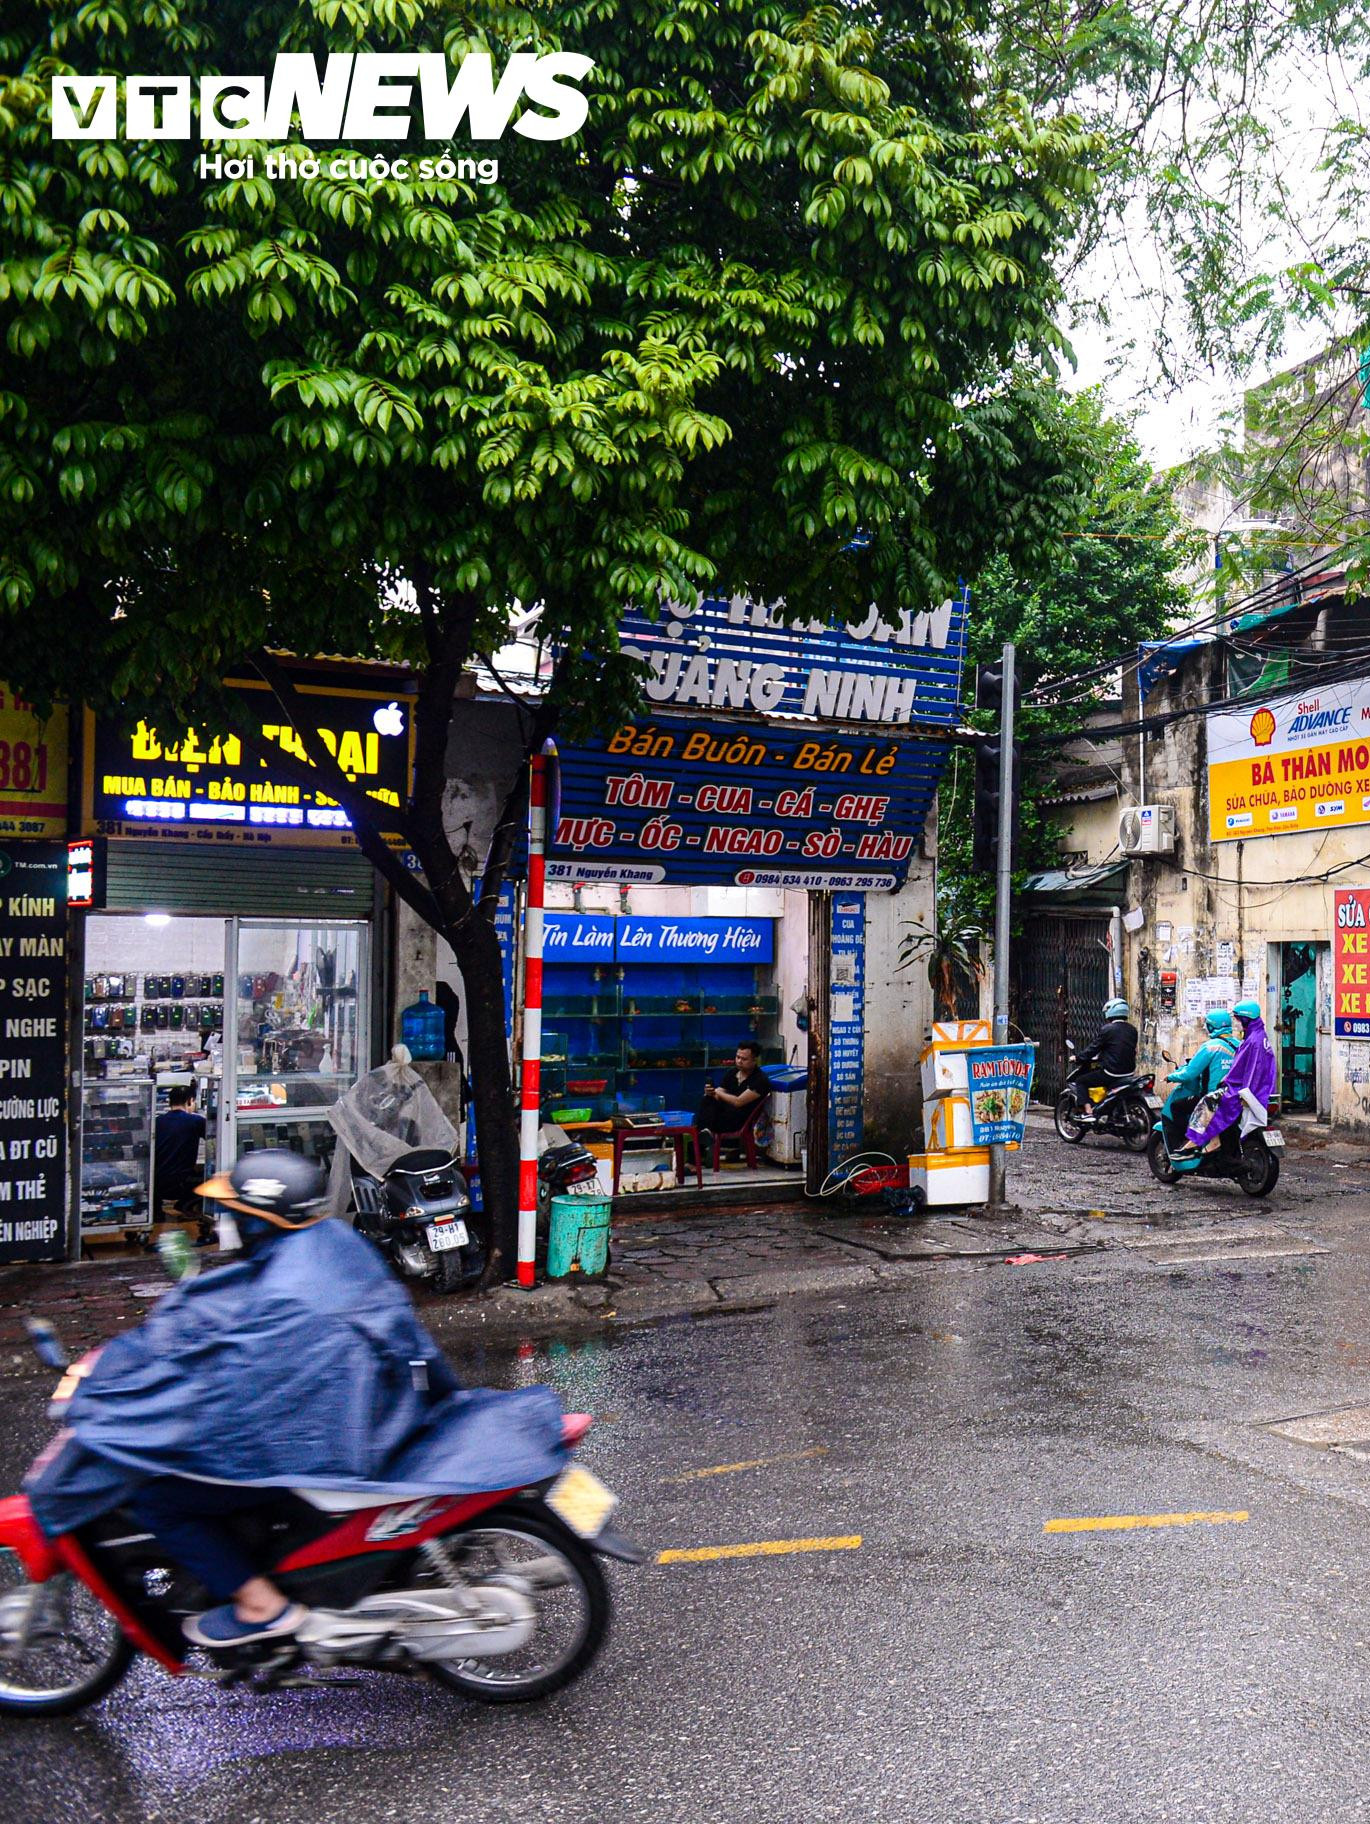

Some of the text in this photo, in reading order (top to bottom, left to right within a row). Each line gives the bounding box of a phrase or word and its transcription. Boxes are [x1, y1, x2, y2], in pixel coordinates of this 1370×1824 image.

[803, 668, 917, 724] NINH
[1297, 699, 1320, 715] Shell
[1288, 706, 1353, 734] ADVANCE
[608, 727, 898, 777] Bán Buôn Bán Lẻ
[1251, 756, 1274, 786] BÁ
[1281, 749, 1332, 783] THÂN
[103, 775, 147, 796] MUA
[151, 775, 191, 799] BÁN
[208, 776, 245, 802] BẢO
[250, 779, 300, 805] HÀNH
[1356, 778, 1370, 793] XE
[605, 775, 891, 828] TÔM CUA CÁ GHẸ
[97, 819, 123, 836] 381
[556, 816, 914, 862] MỰC ỐC NGAO SÒ HÀU
[548, 864, 653, 881] 381 Nguyễn Khang
[755, 873, 893, 888] 0984 634 410 0963 295 736
[9, 894, 55, 917] KÍNH
[1337, 894, 1366, 928] SỬA
[842, 919, 855, 929] CUA
[20, 934, 63, 957] MÀN
[543, 922, 762, 954] Tín Làm Lên Thương Hiệu
[1341, 933, 1368, 954] XE
[1341, 963, 1368, 985] XE
[12, 977, 50, 1001] SẠC
[1340, 992, 1361, 1014] XE
[6, 1018, 57, 1037] NGHE
[1353, 1022, 1370, 1034] 0983
[1, 1059, 31, 1079] PIN
[973, 1060, 996, 1079] RAM
[38, 1097, 60, 1122] LỰC
[10, 1135, 57, 1160] ĐT CŨ
[16, 1173, 46, 1200] THẺ
[15, 1216, 58, 1243] NGHIỆP
[433, 1223, 459, 1237] 29-H1
